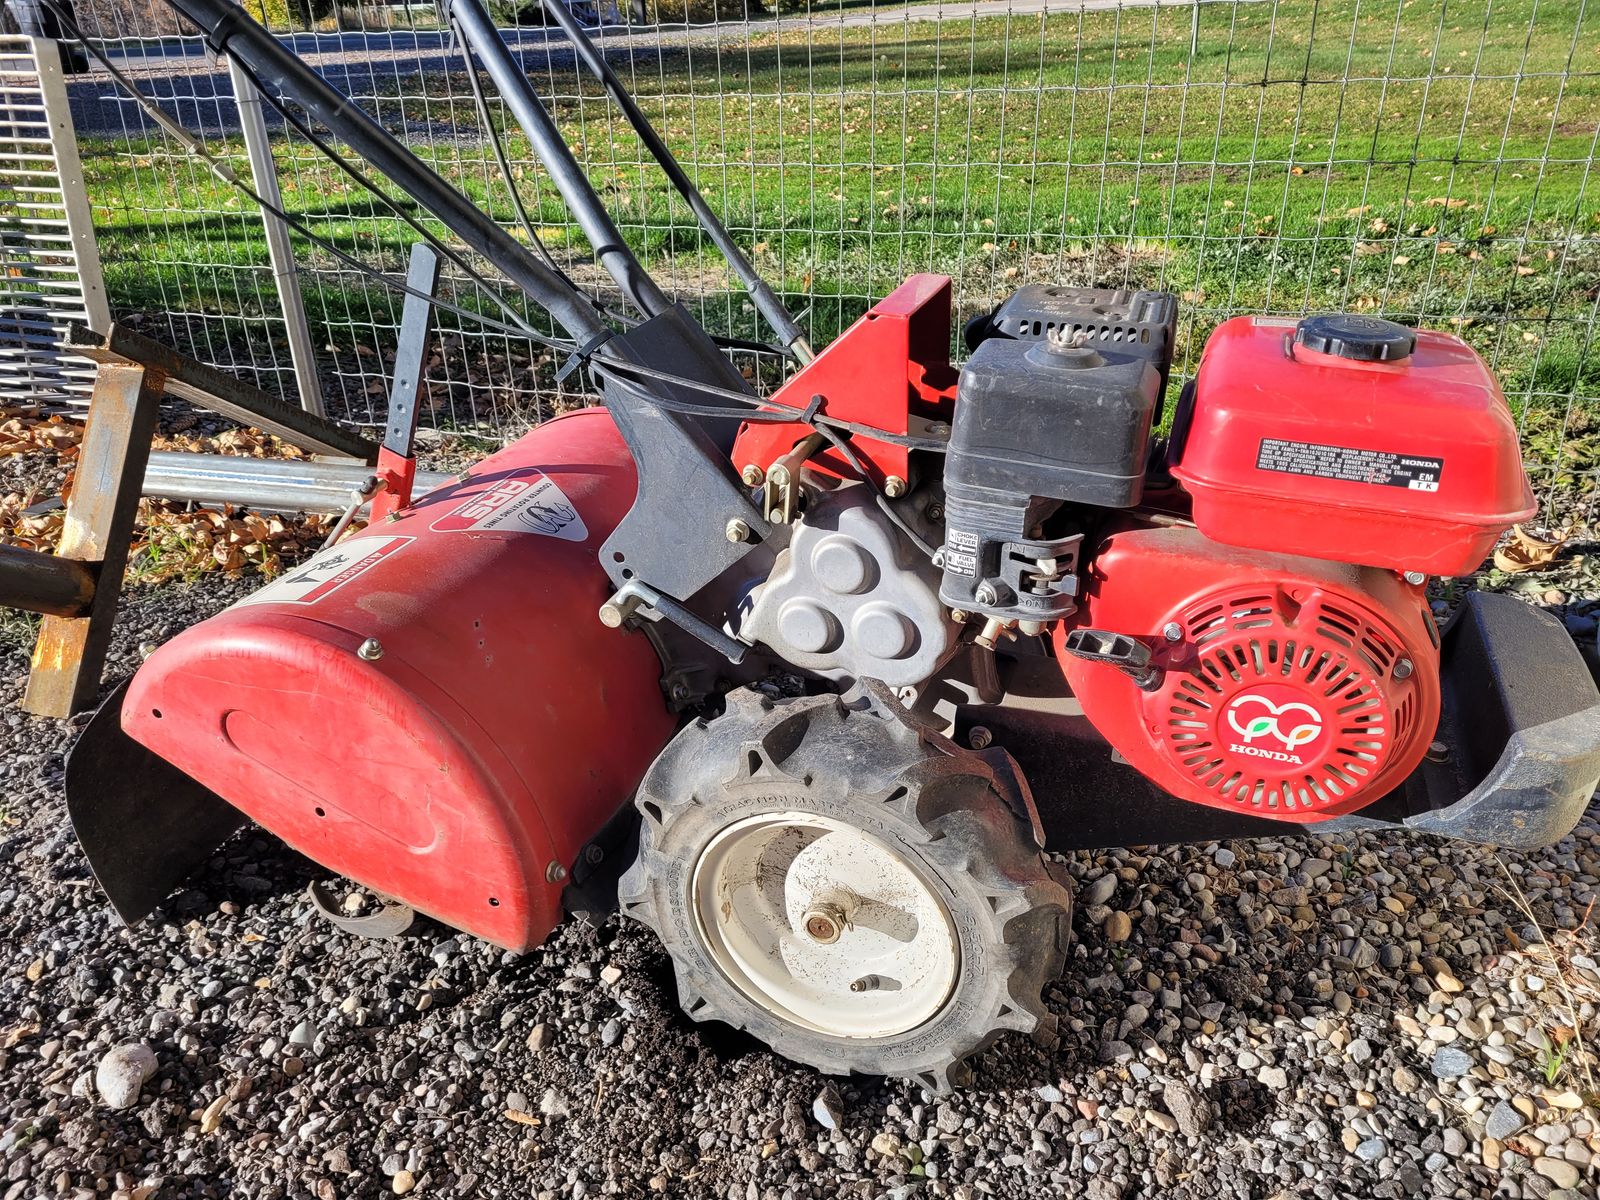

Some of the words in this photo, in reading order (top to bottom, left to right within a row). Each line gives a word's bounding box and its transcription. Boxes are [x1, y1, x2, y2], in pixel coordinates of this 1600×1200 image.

[1260, 454, 1292, 462] MAINTENANCE
[1293, 458, 1329, 467] SPECIFICATIONS
[1283, 452, 1316, 460] SPECIFICATION
[1401, 459, 1440, 469] HONDA
[1335, 473, 1362, 481] EQUIPMENT
[1419, 473, 1434, 482] EM
[528, 482, 552, 500] COUNTER
[461, 480, 529, 519] ARS
[500, 498, 527, 519] ROTATING
[483, 514, 503, 529] TINES
[957, 532, 978, 540] CHOKE
[957, 537, 977, 546] LEVER
[330, 555, 373, 584] DANGER
[957, 560, 975, 568] VALVE
[1229, 743, 1303, 765] HONDA
[668, 860, 707, 969] BRIDGESTONE
